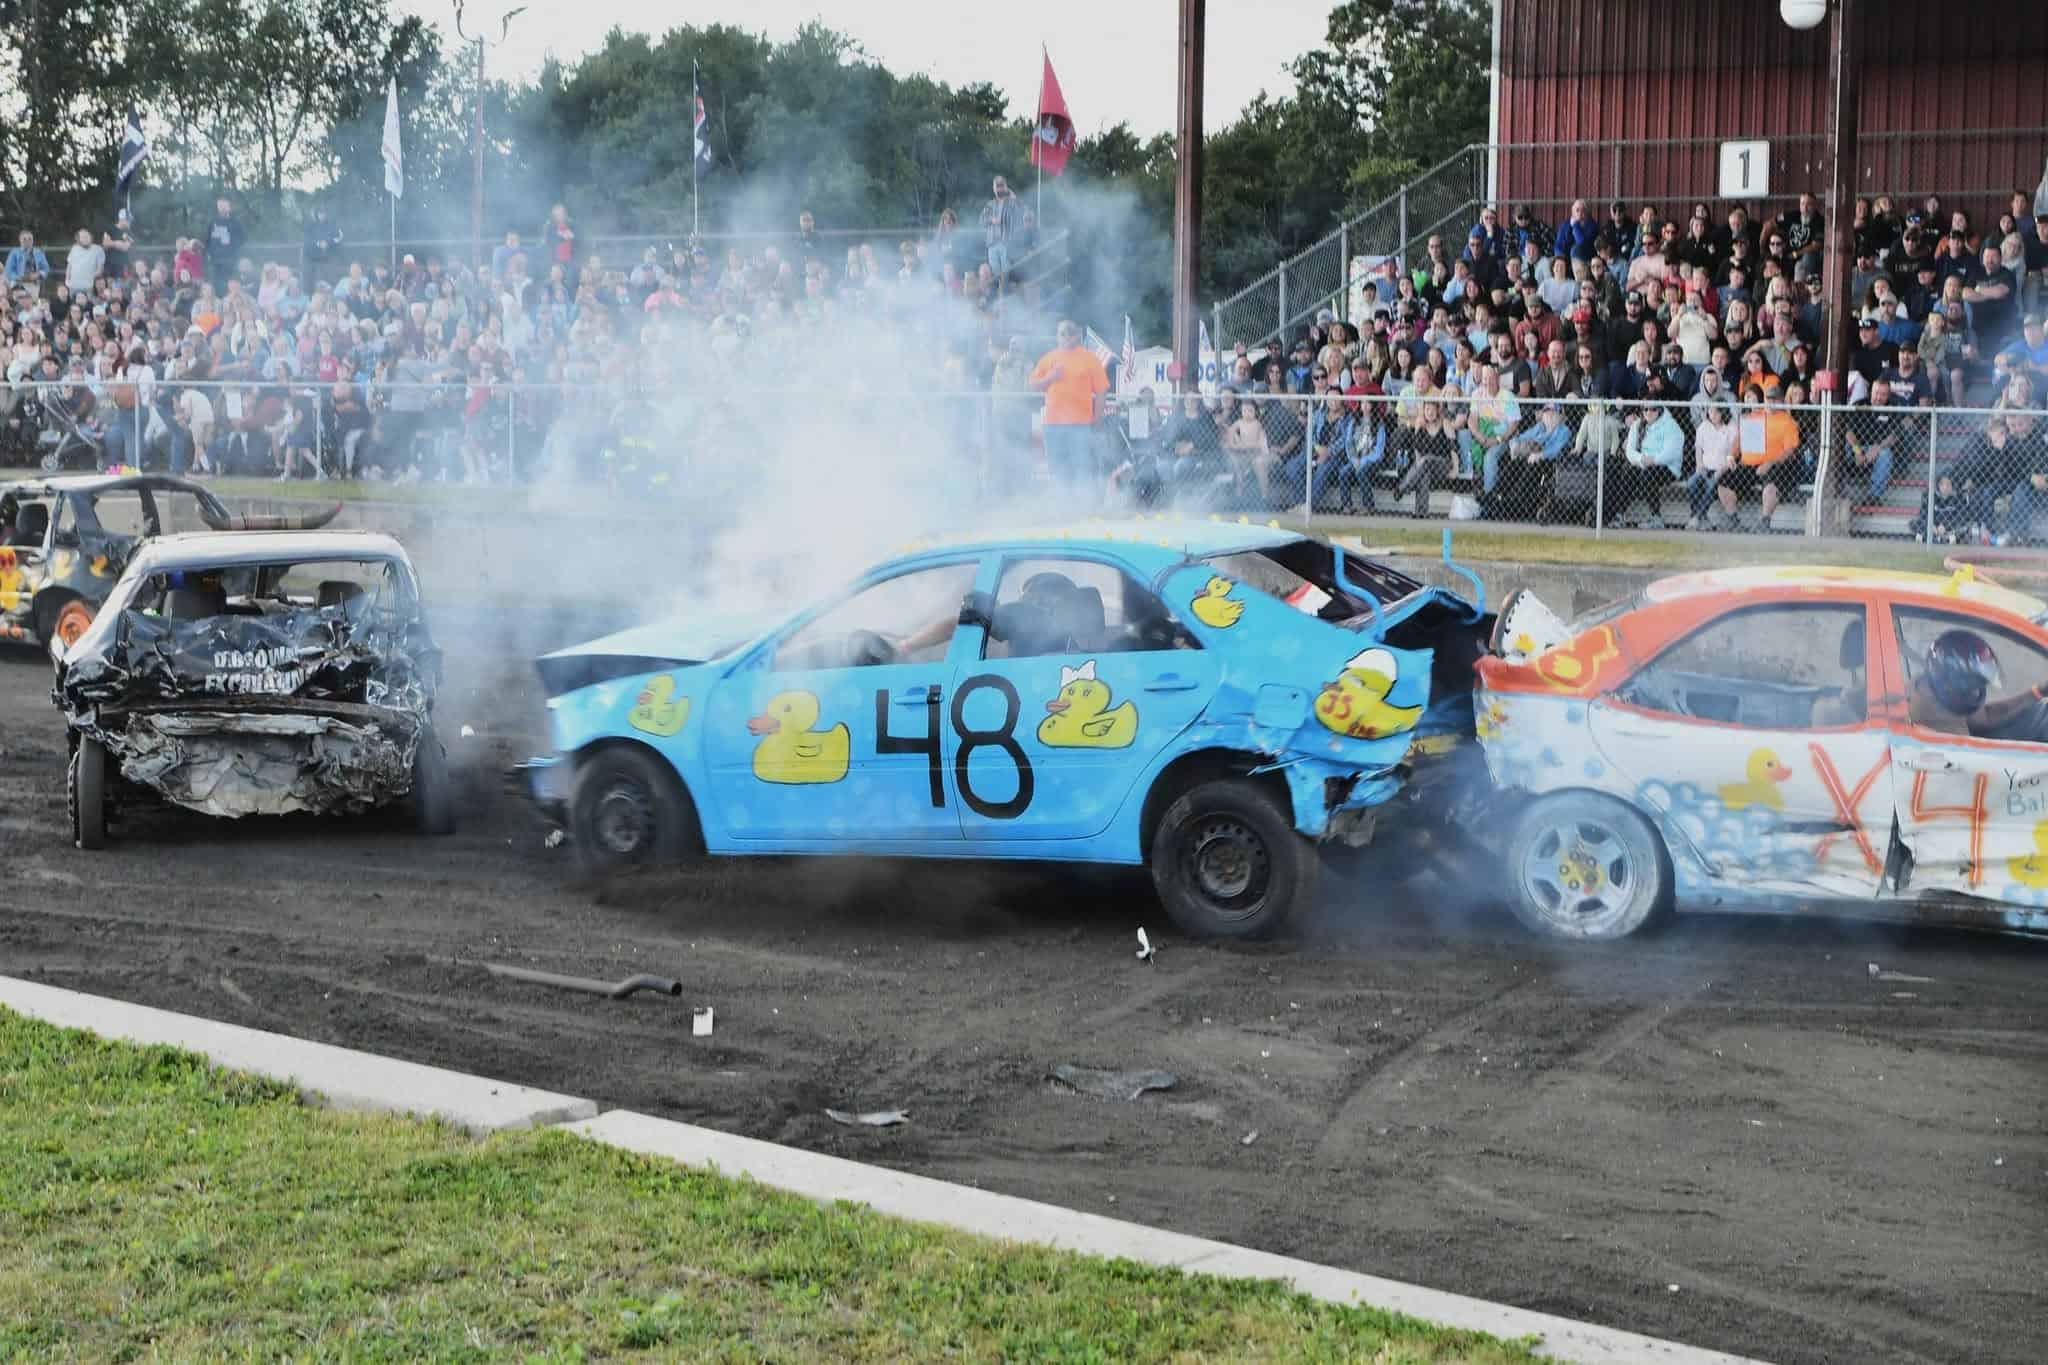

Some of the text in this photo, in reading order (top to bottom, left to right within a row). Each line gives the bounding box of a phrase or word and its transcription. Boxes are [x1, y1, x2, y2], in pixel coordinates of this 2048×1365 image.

[1739, 148, 1750, 189] 1
[875, 673, 1034, 820] 48
[1808, 741, 1988, 888] X4
